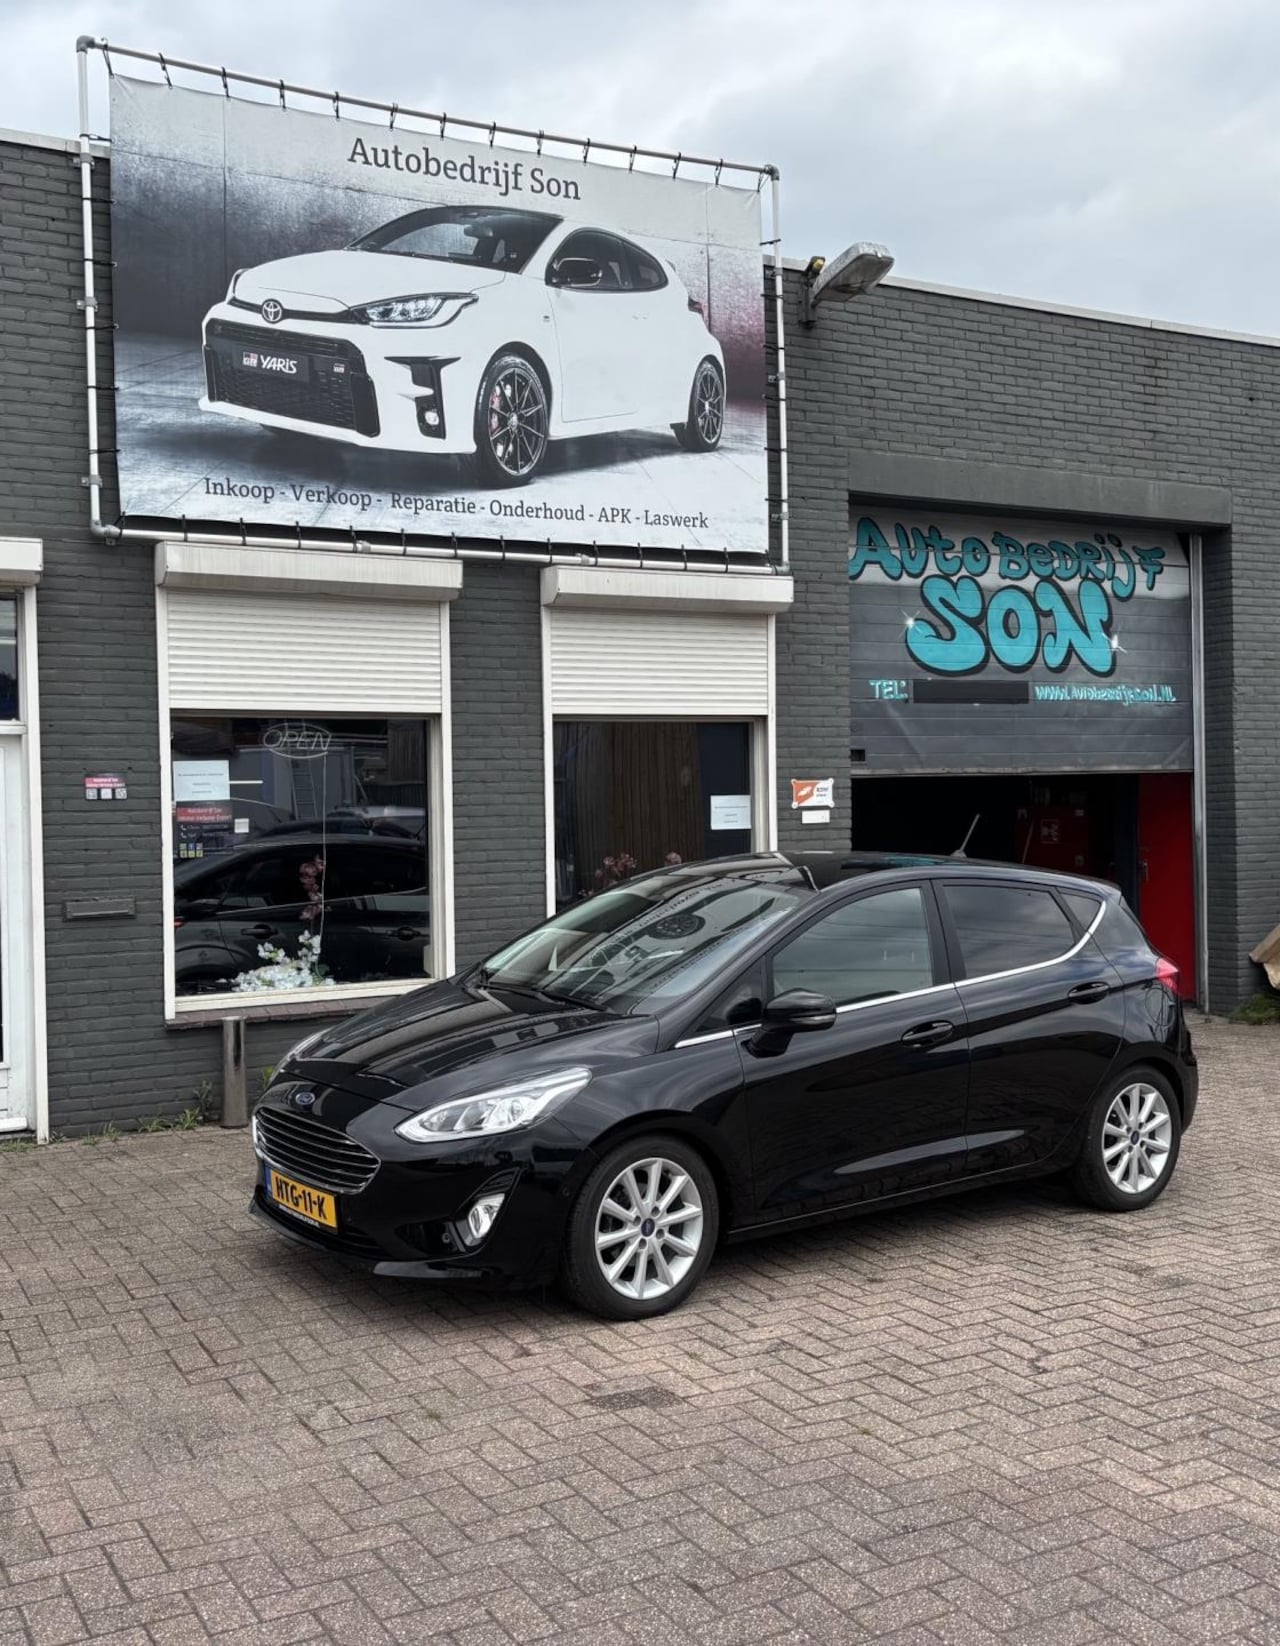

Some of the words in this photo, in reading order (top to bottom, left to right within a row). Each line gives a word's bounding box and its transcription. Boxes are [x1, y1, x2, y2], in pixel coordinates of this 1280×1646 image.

[347, 137, 523, 196] Autobedrijf
[530, 168, 581, 200] Son
[204, 478, 275, 504] Inkoop
[290, 484, 372, 510] Verkoop
[390, 492, 476, 515] Reparatie
[489, 499, 585, 521] Onderhoud
[598, 507, 631, 524] APK
[643, 509, 709, 528] Laswerk
[905, 575, 1116, 677] SON
[263, 729, 332, 751] OPEN
[275, 1176, 328, 1220] HTG-11-K
